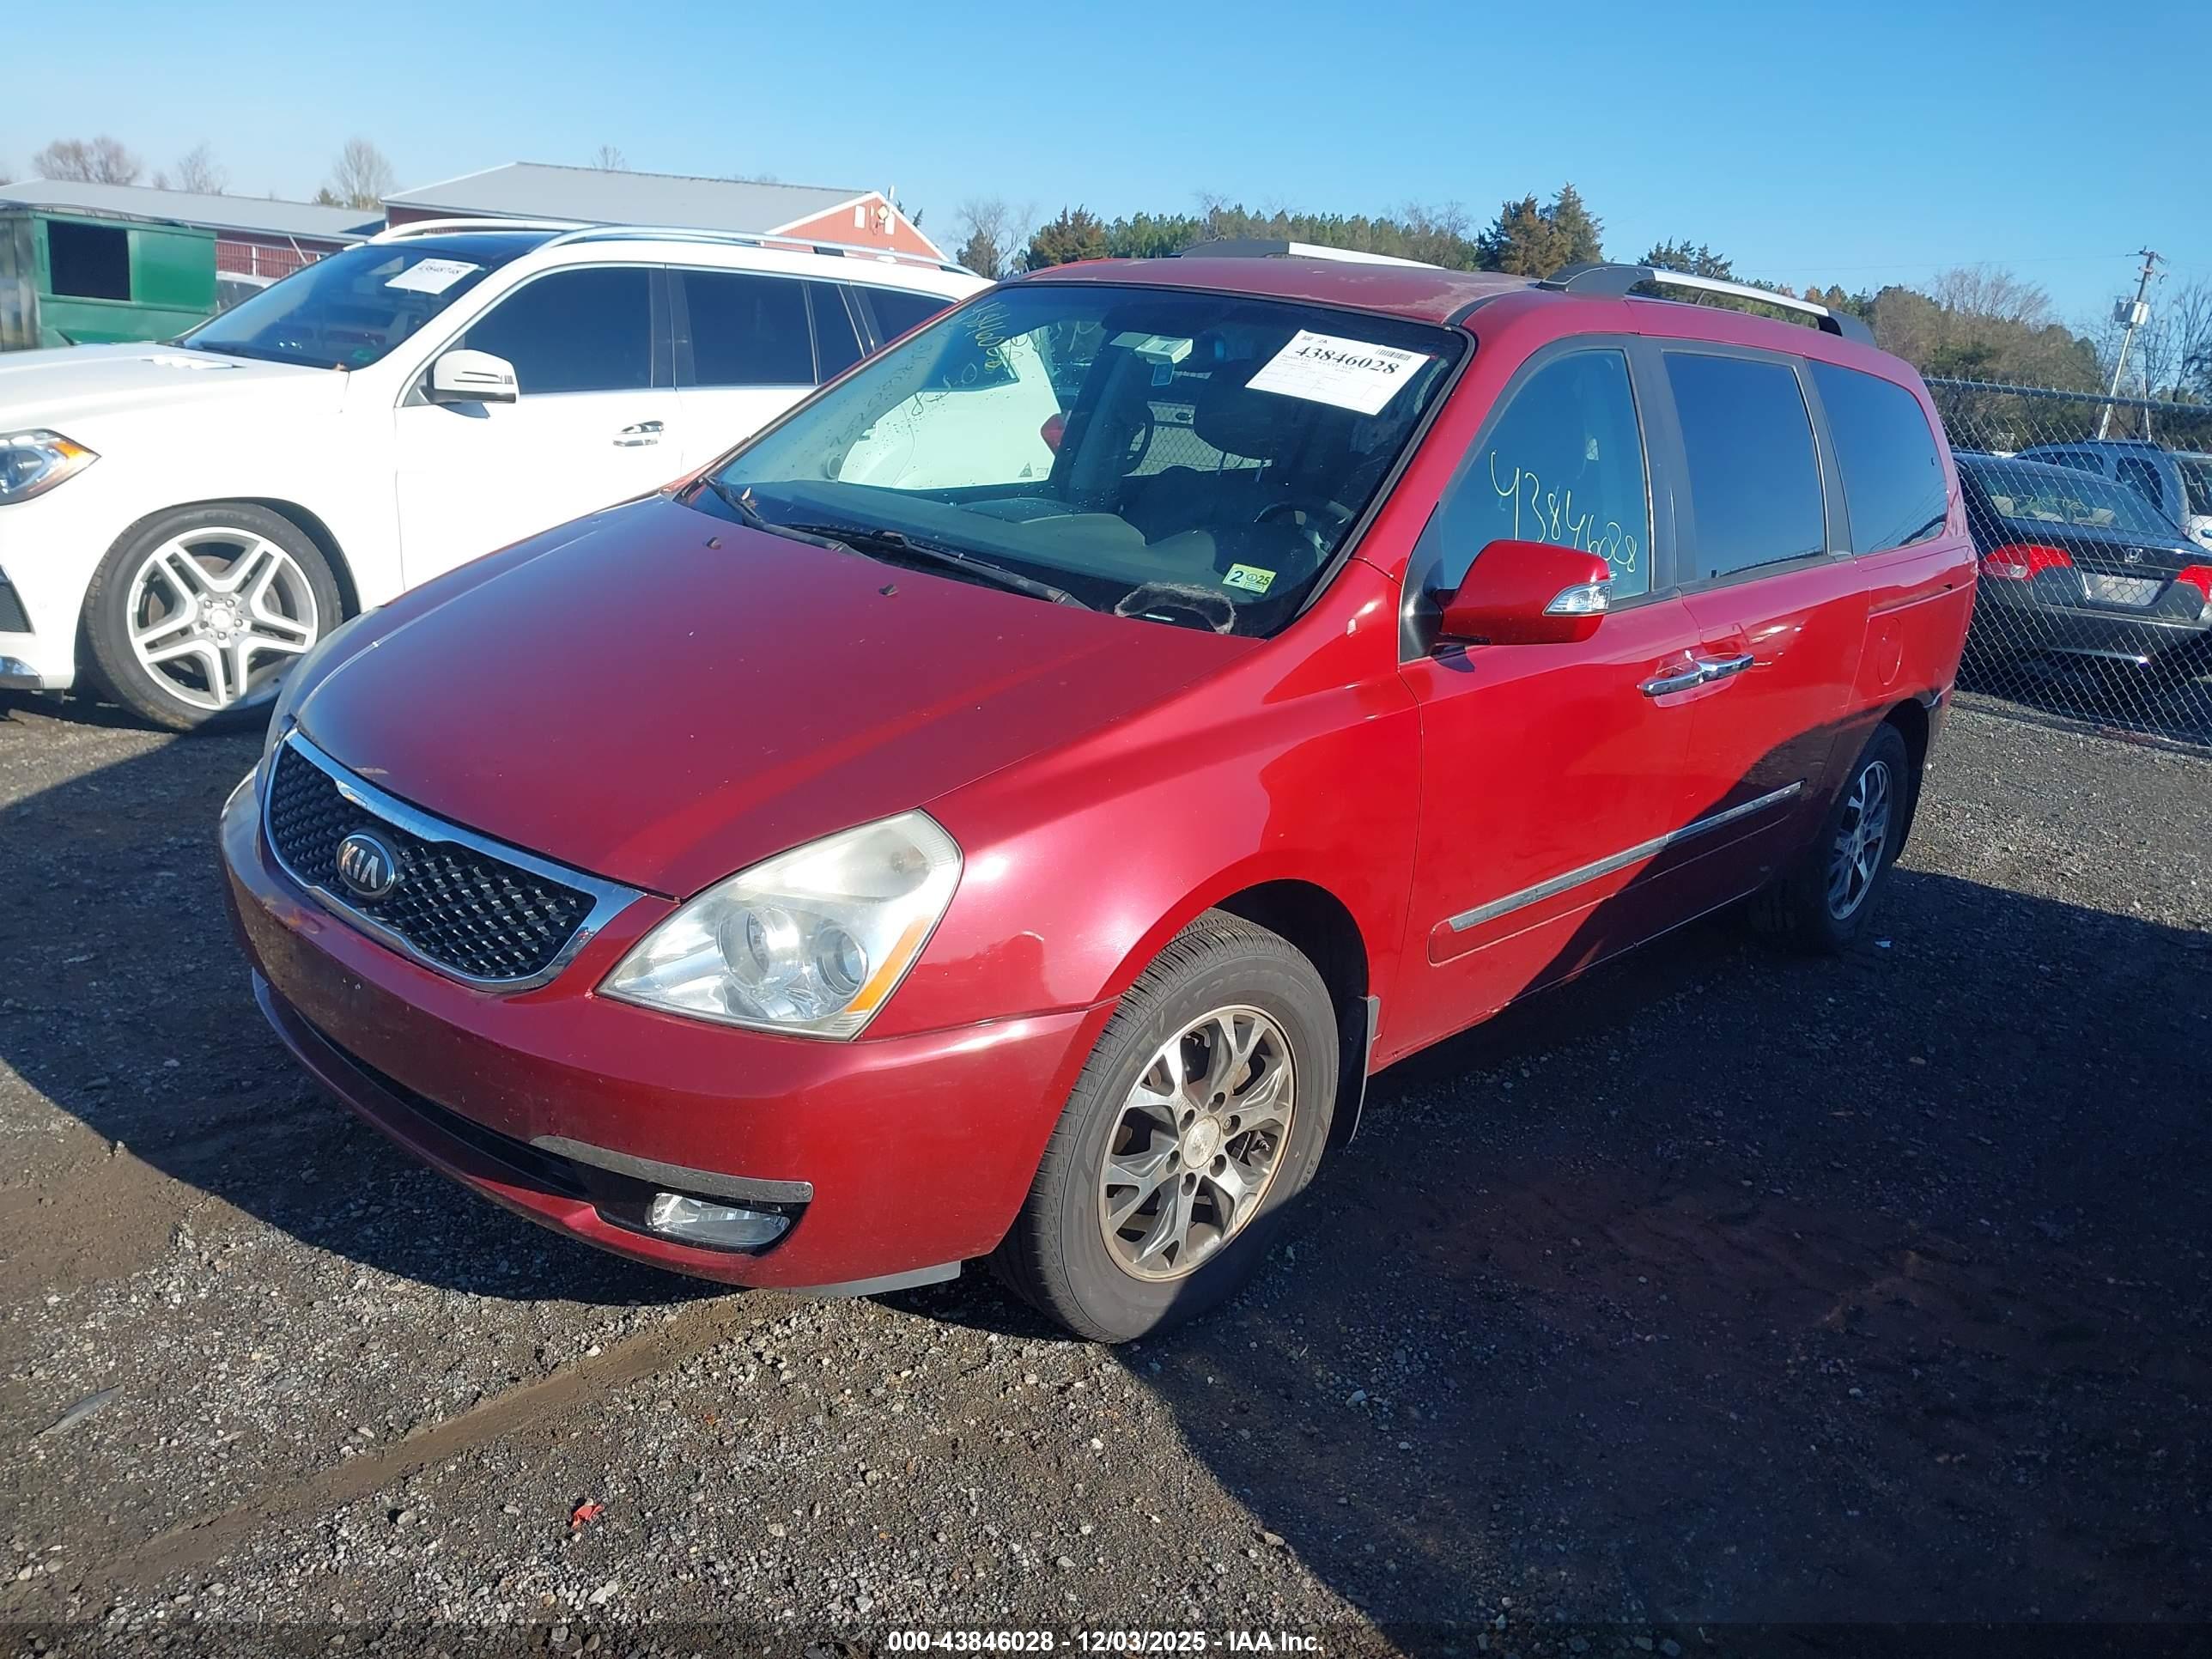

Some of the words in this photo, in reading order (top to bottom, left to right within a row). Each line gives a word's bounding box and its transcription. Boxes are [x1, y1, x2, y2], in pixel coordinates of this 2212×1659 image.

[1295, 346, 1400, 374] 43846028
[1230, 570, 1244, 583] 2
[1256, 574, 1271, 586] 25
